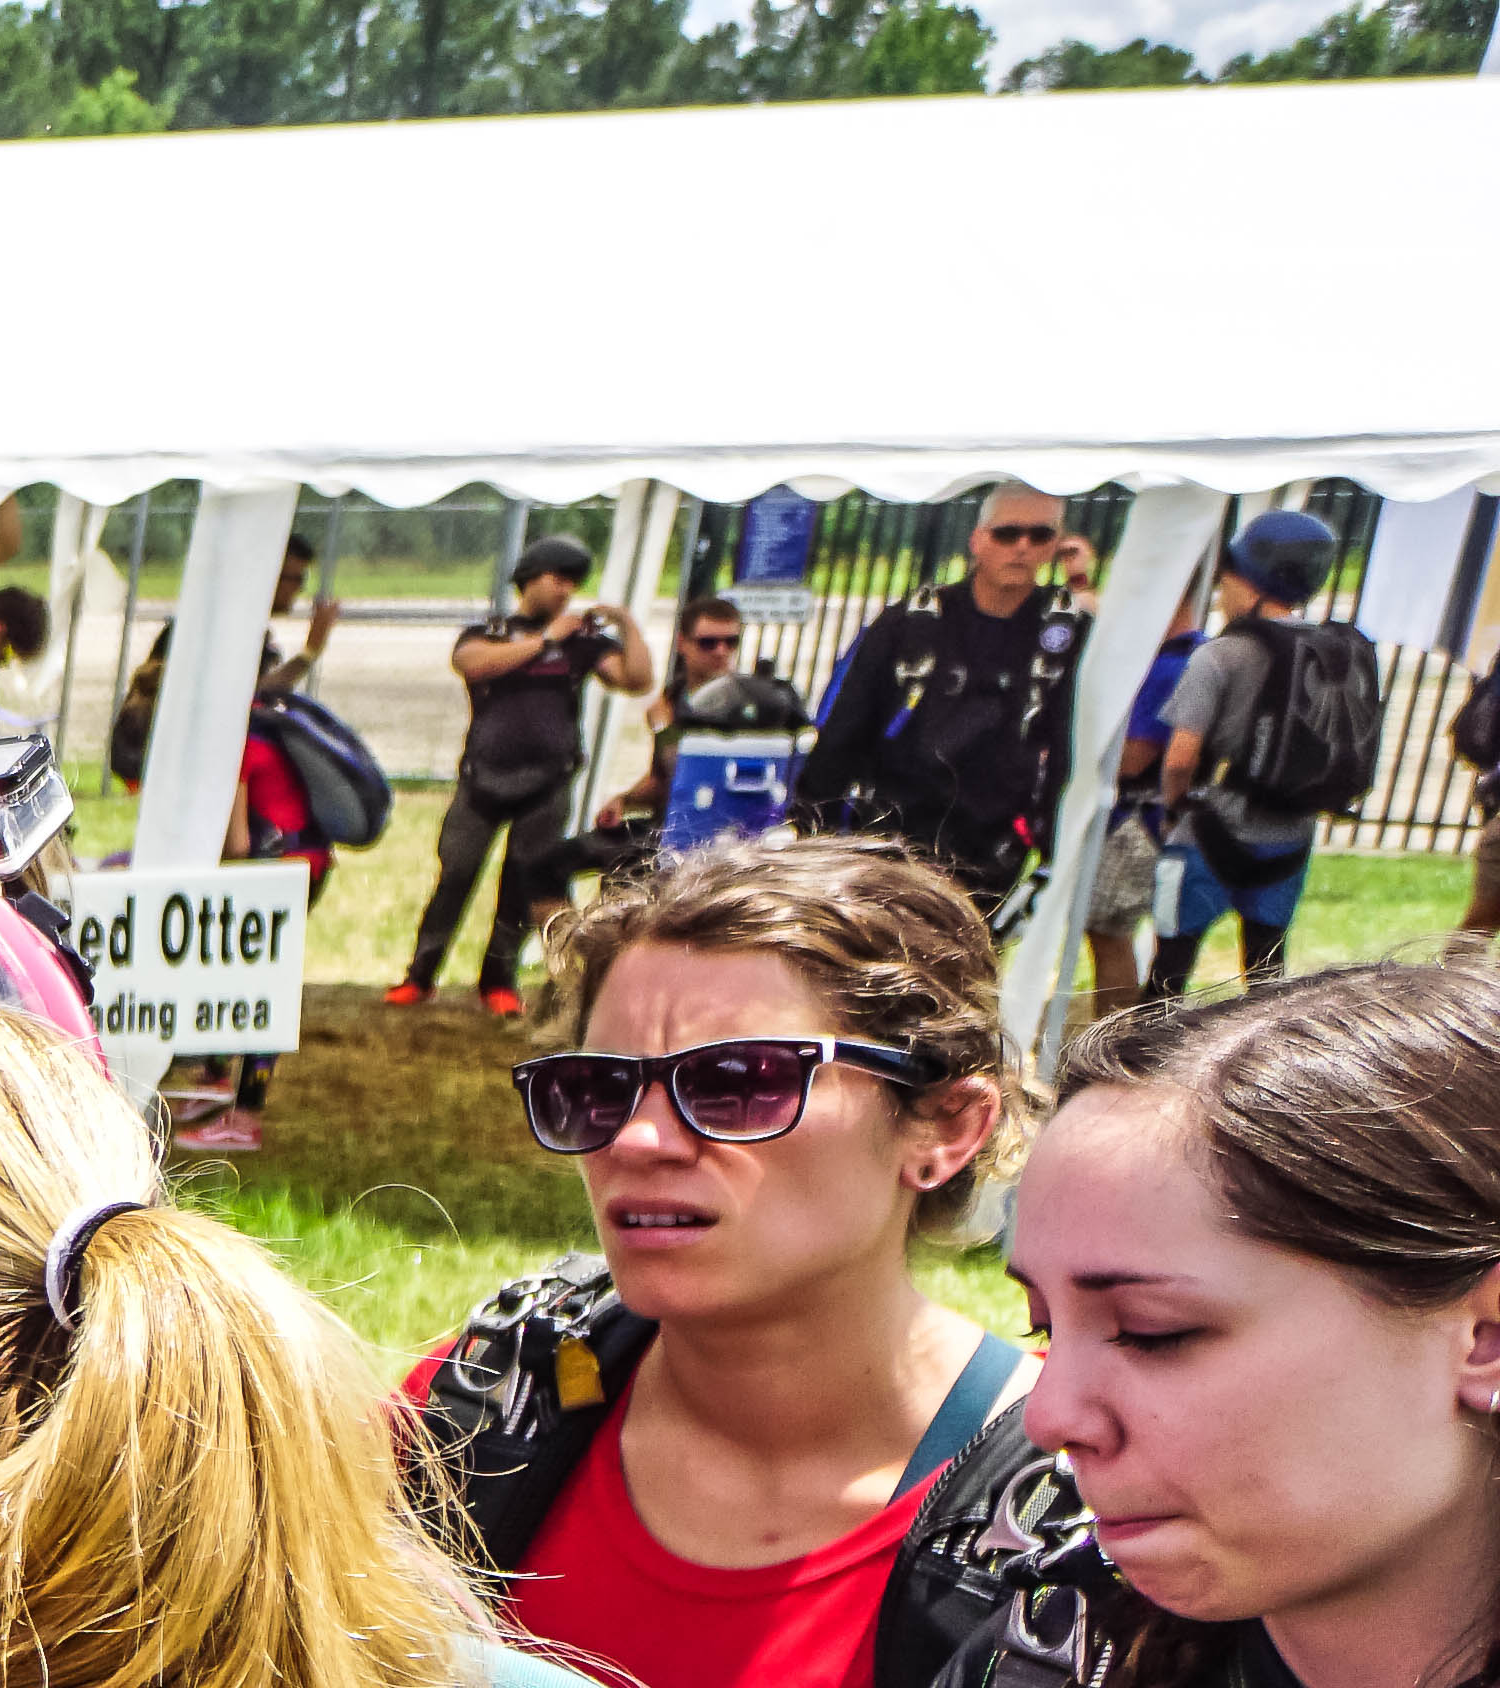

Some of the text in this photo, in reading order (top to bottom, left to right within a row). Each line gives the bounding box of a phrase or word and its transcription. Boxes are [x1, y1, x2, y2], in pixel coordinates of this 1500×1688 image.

[70, 890, 291, 968] ed Otter
[194, 998, 271, 1032] area
